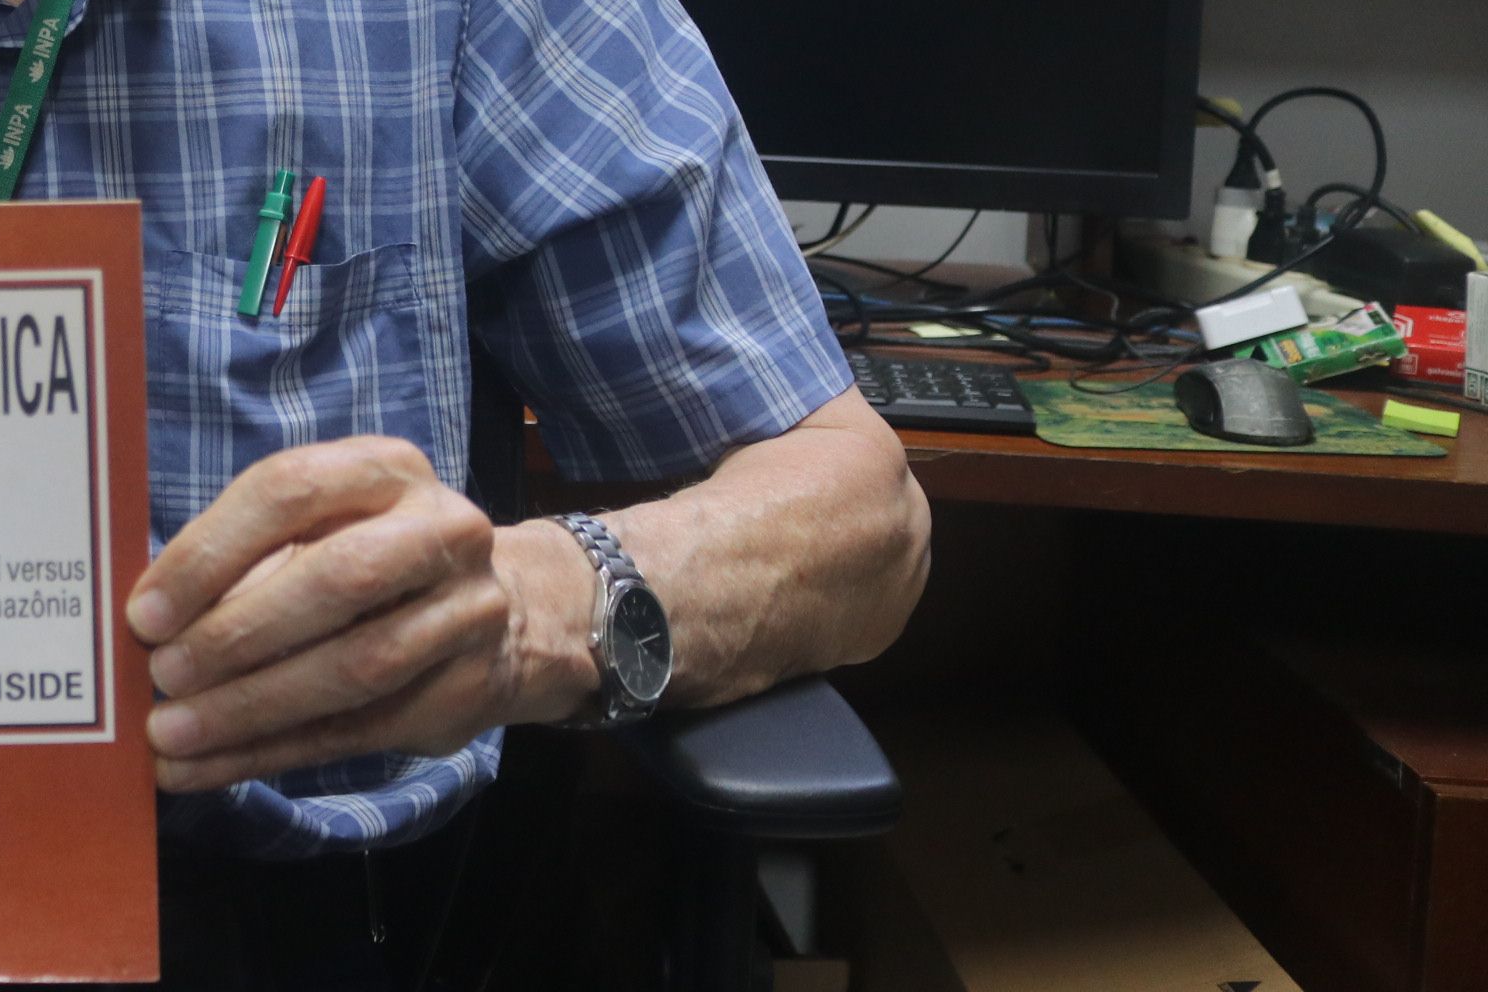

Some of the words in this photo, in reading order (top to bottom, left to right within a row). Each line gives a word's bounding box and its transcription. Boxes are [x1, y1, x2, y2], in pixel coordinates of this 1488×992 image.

[33, 17, 61, 59] INPA
[3, 103, 33, 147] INPA
[6, 559, 86, 583] versus
